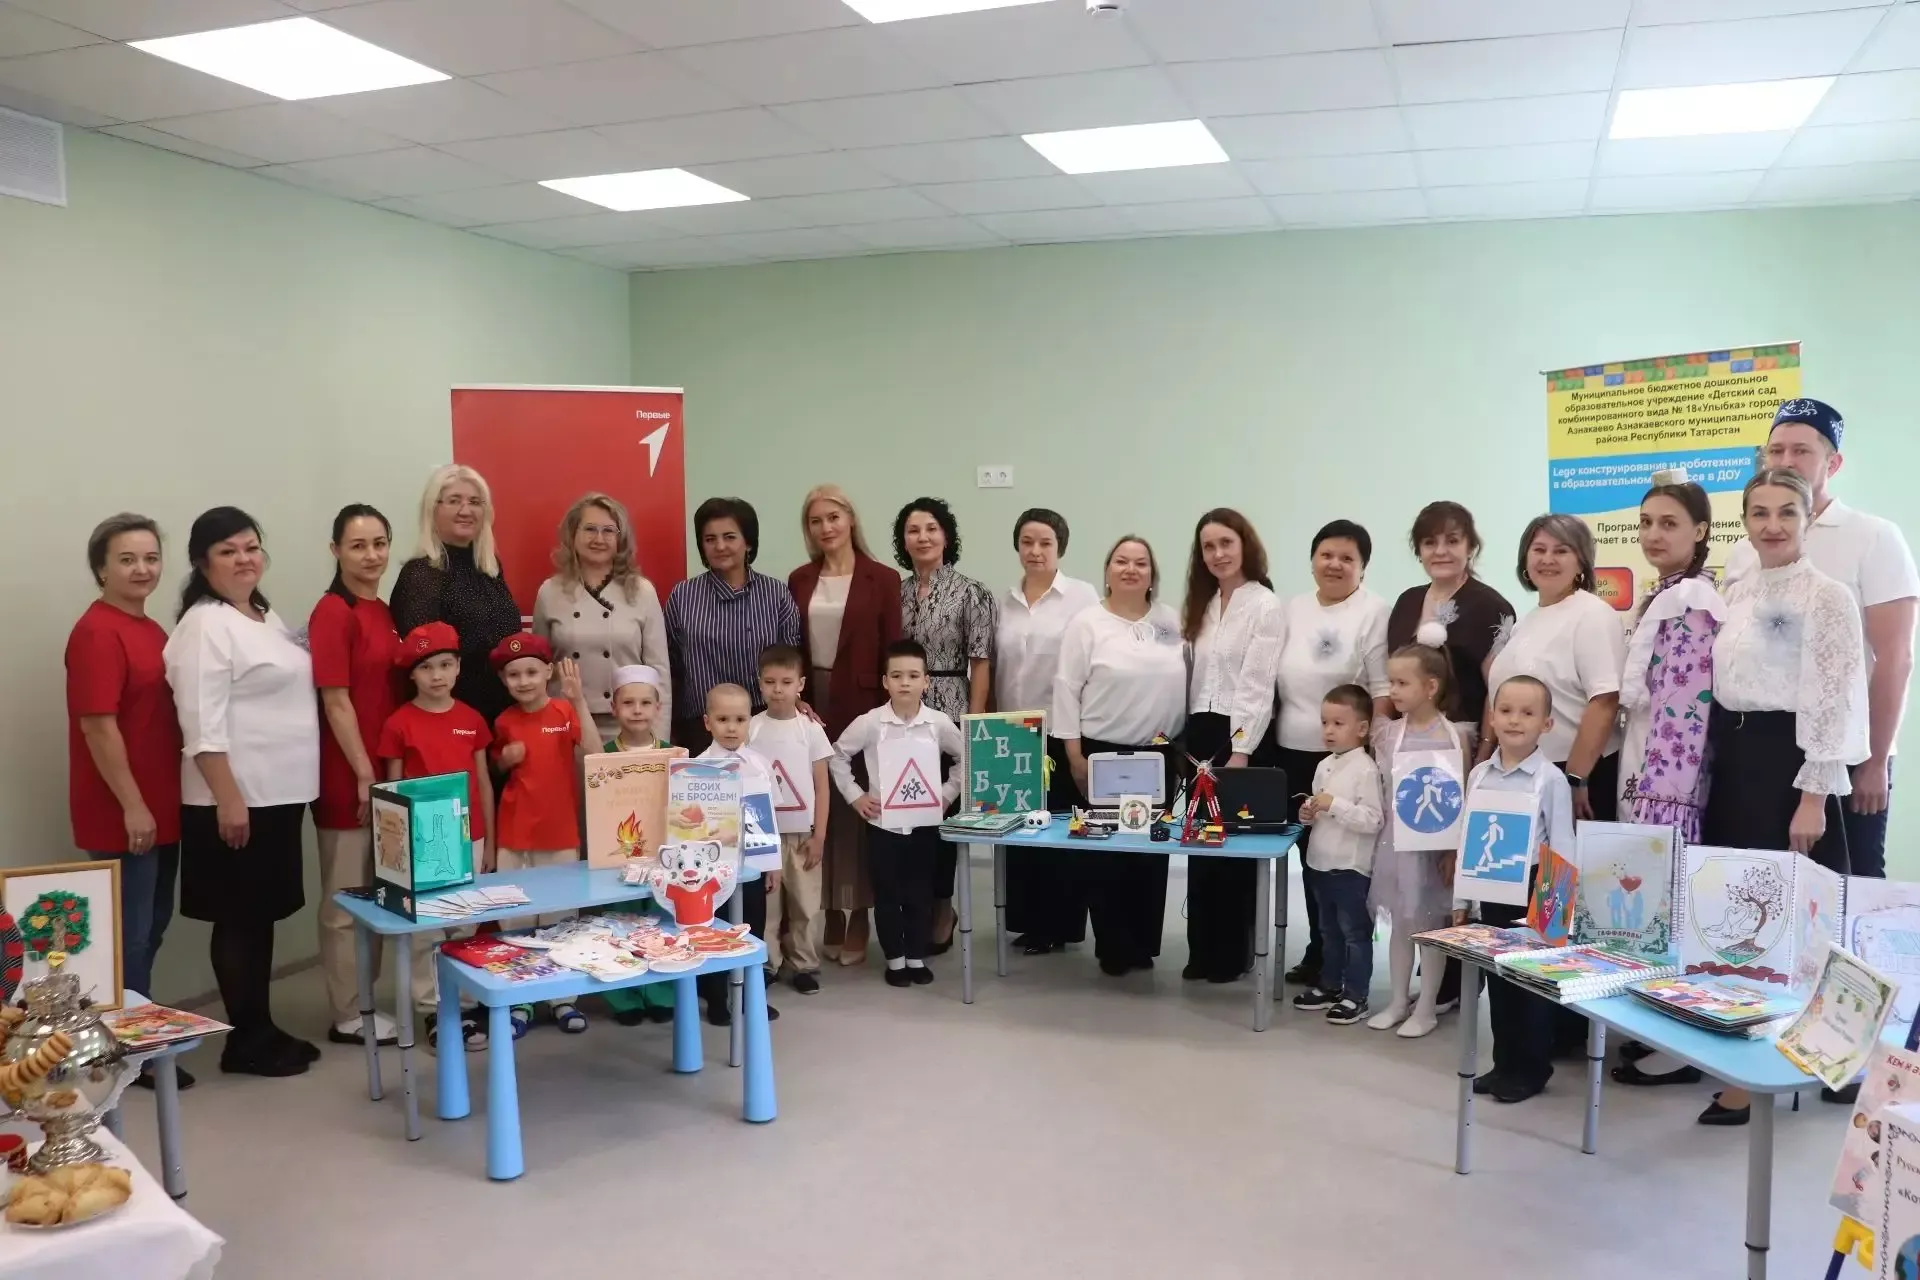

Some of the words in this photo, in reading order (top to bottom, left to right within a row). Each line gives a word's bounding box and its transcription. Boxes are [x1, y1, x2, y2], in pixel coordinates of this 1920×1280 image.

[1571, 387, 1645, 402] Муниципальное
[1647, 382, 1702, 393] бюджетное
[1704, 375, 1768, 389] дошкольное
[1565, 399, 1644, 413] образовательное
[1647, 394, 1705, 407] учреждение
[1708, 388, 1754, 400] «Детский
[1758, 387, 1777, 396] сад
[636, 410, 671, 420] Первые
[1558, 411, 1644, 425] комбинированного
[1647, 408, 1669, 417] вида
[1672, 406, 1683, 414] №
[1567, 426, 1615, 435] Азнакаево
[1617, 417, 1685, 431] Азнакаевского
[1688, 412, 1775, 426] муниципального
[1596, 434, 1628, 446] района
[1631, 428, 1687, 443] Республики
[1690, 427, 1740, 438] Татарстан
[1553, 467, 1576, 478] Lego
[1578, 462, 1667, 476] конструирование
[1669, 461, 1677, 469] и
[1561, 476, 1652, 490] образовательном
[1707, 473, 1715, 481] в
[1717, 469, 1741, 482] ДОУ
[1597, 522, 1641, 534] Програм
[1592, 536, 1619, 545] чает
[1596, 589, 1619, 597] ation
[687, 782, 721, 792] СВОИХ
[671, 792, 685, 801] НЕ
[687, 792, 737, 801] БРОСАЕМ!
